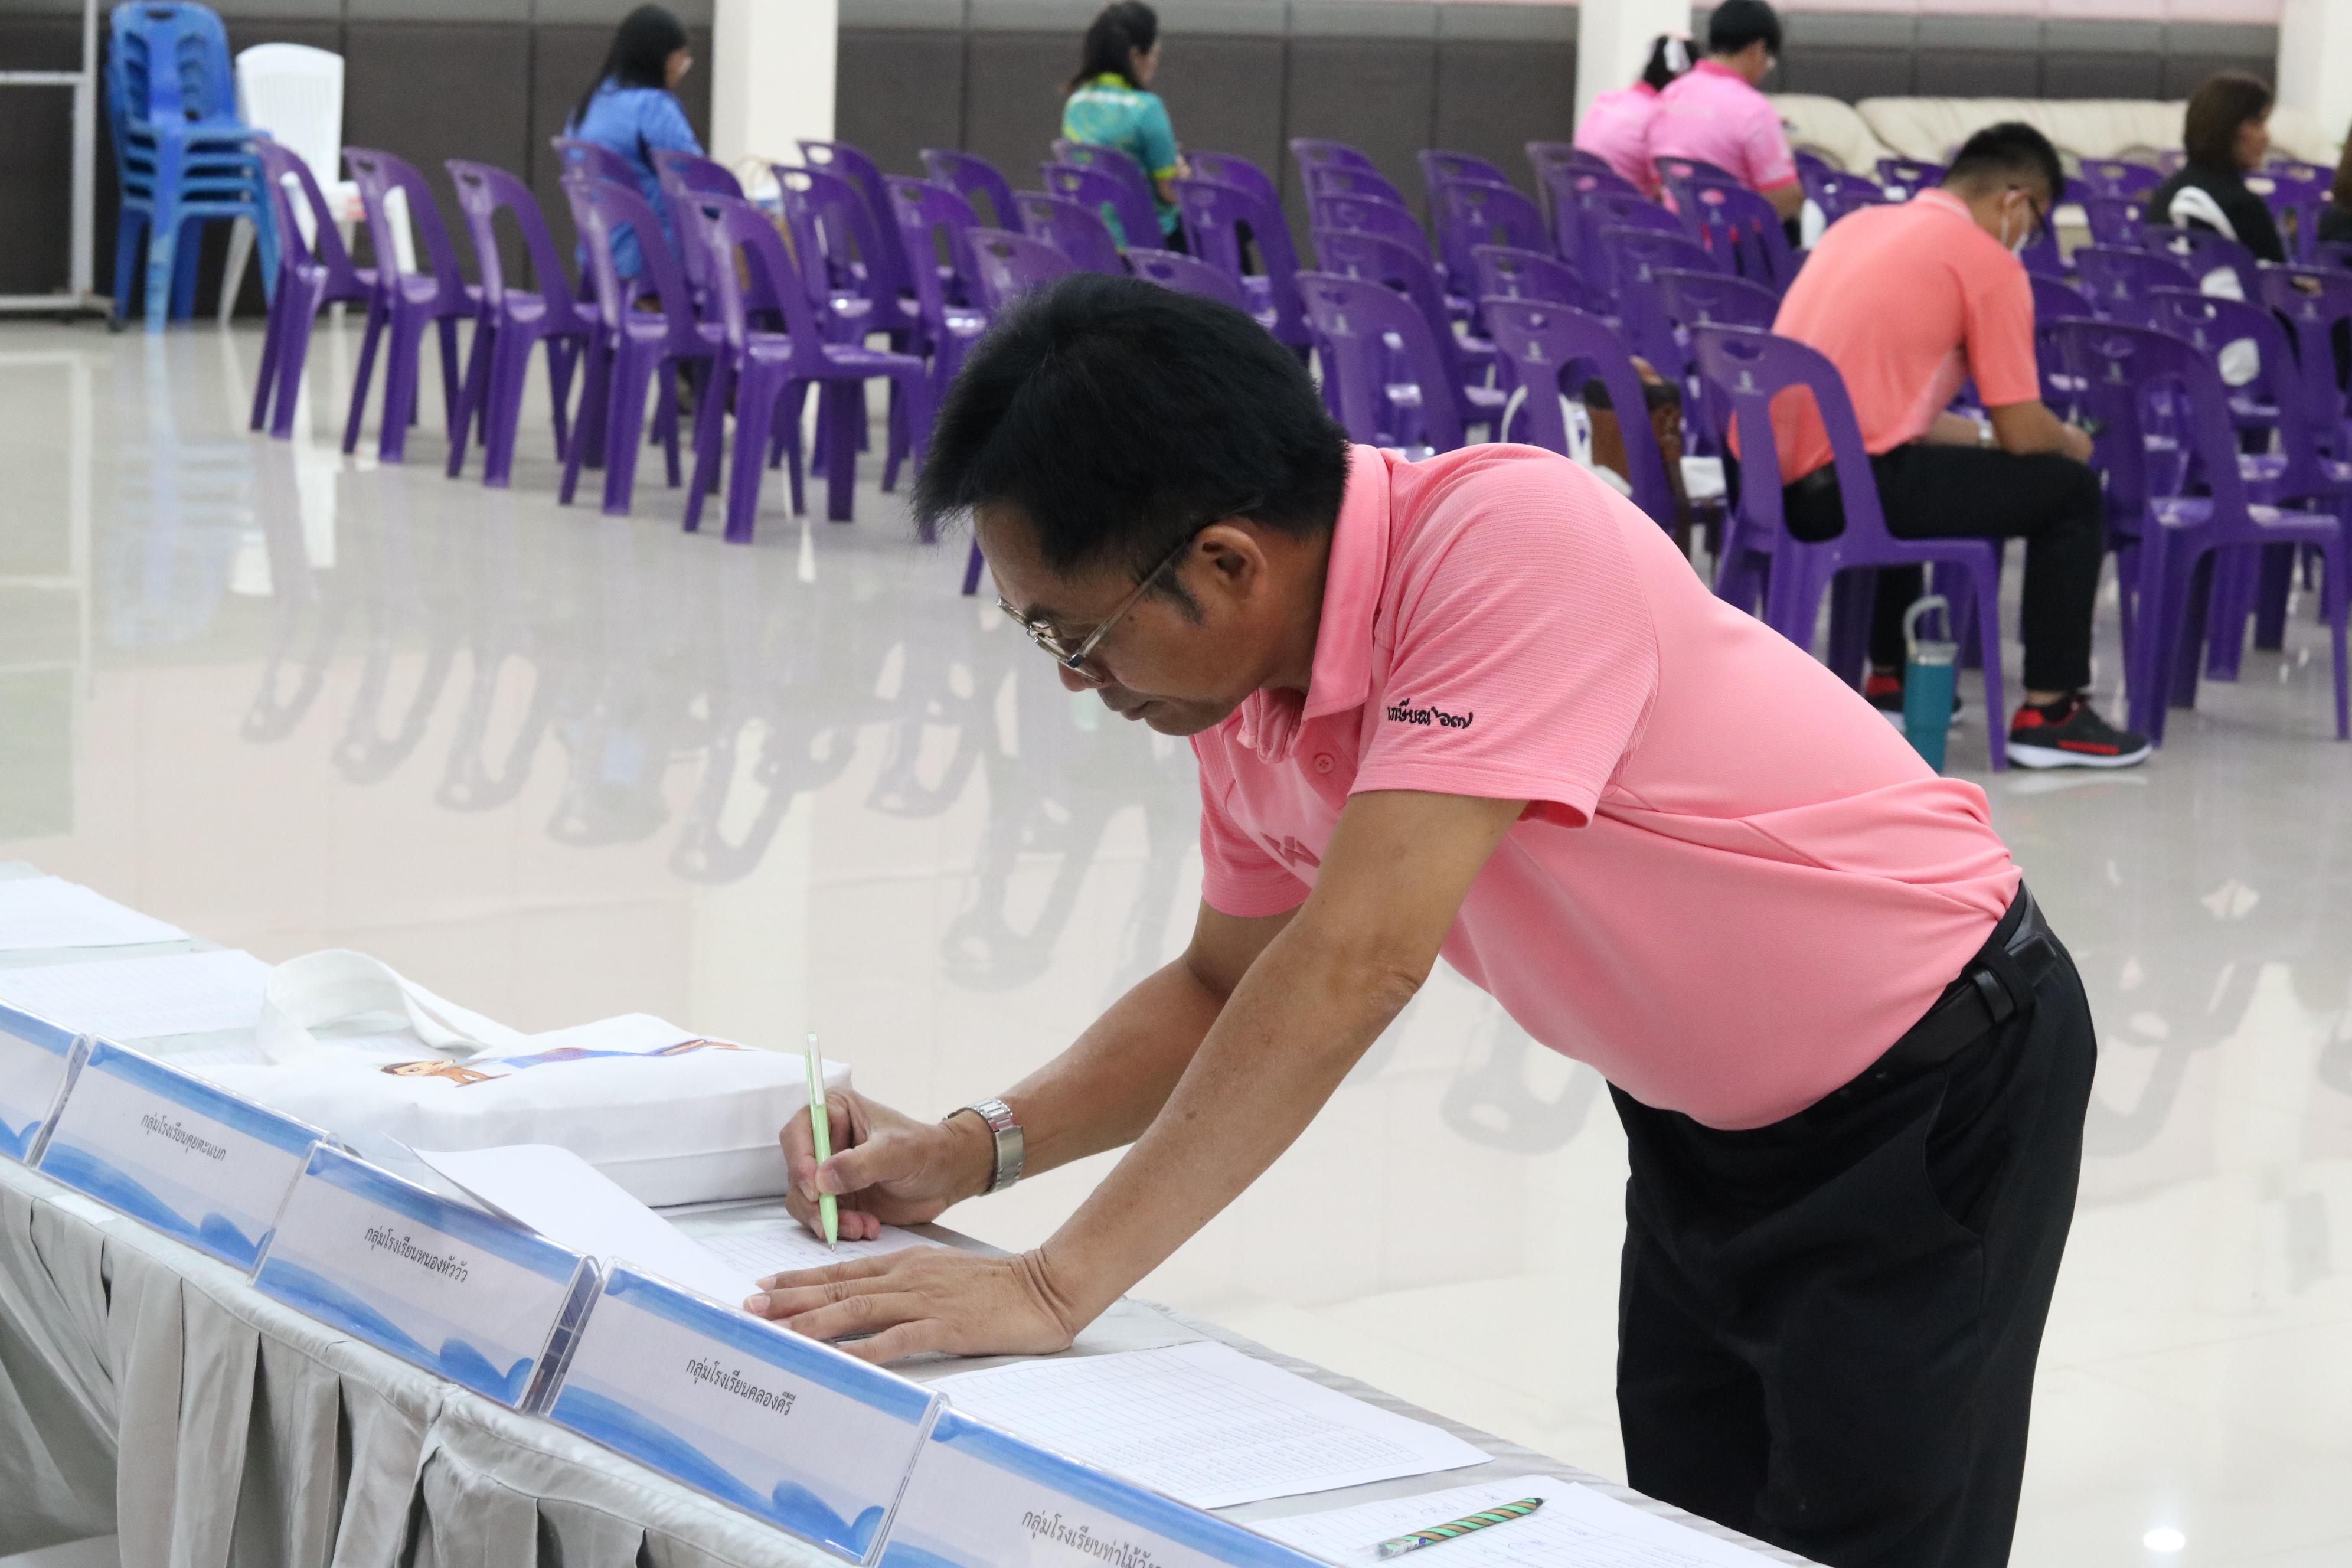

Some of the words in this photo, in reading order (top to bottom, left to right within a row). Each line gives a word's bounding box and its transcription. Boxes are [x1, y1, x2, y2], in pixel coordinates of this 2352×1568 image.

[364, 1225, 468, 1283] กลุ่มโรงเรียนหนองหัววัว
[685, 1357, 796, 1416] กลุ่มโรงเรียนคลองคีรี
